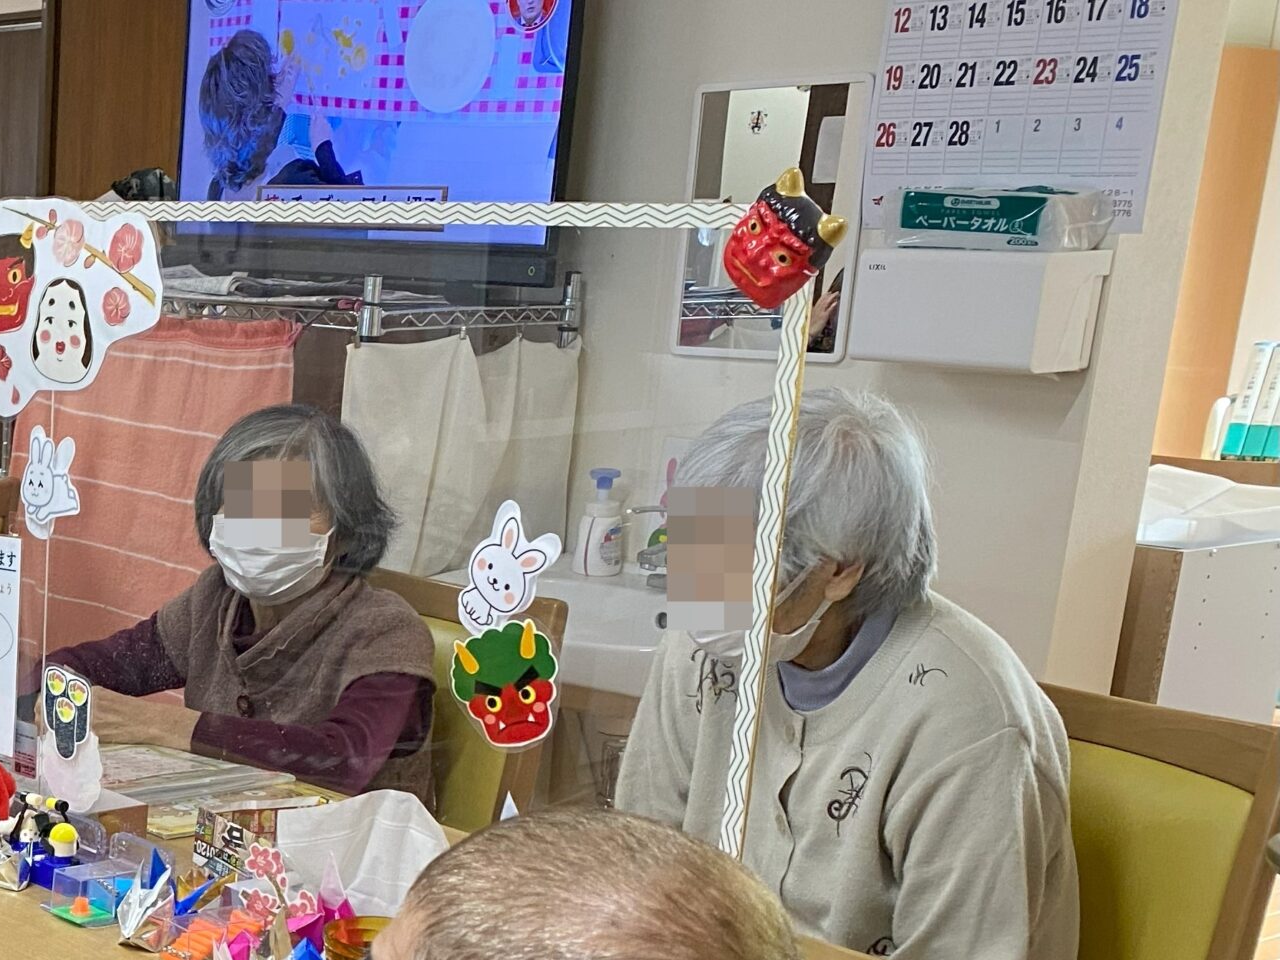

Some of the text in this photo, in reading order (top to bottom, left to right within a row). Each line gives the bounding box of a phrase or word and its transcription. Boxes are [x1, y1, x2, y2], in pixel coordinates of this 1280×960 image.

[894, 7, 912, 34] 12
[929, 4, 950, 32] 13
[968, 2, 988, 29] 14
[1006, 0, 1027, 27] 15
[1046, 0, 1067, 24] 16
[1087, 0, 1108, 22] 17
[1129, 0, 1150, 20] 18
[885, 65, 904, 91] 19
[918, 63, 942, 90] 20
[955, 61, 978, 88] 21
[993, 60, 1018, 87] 22
[1033, 58, 1058, 85] 23
[1073, 56, 1099, 84] 24
[1115, 54, 1142, 82] 25
[875, 116, 1124, 148] 26 27 28 1 2 3 4
